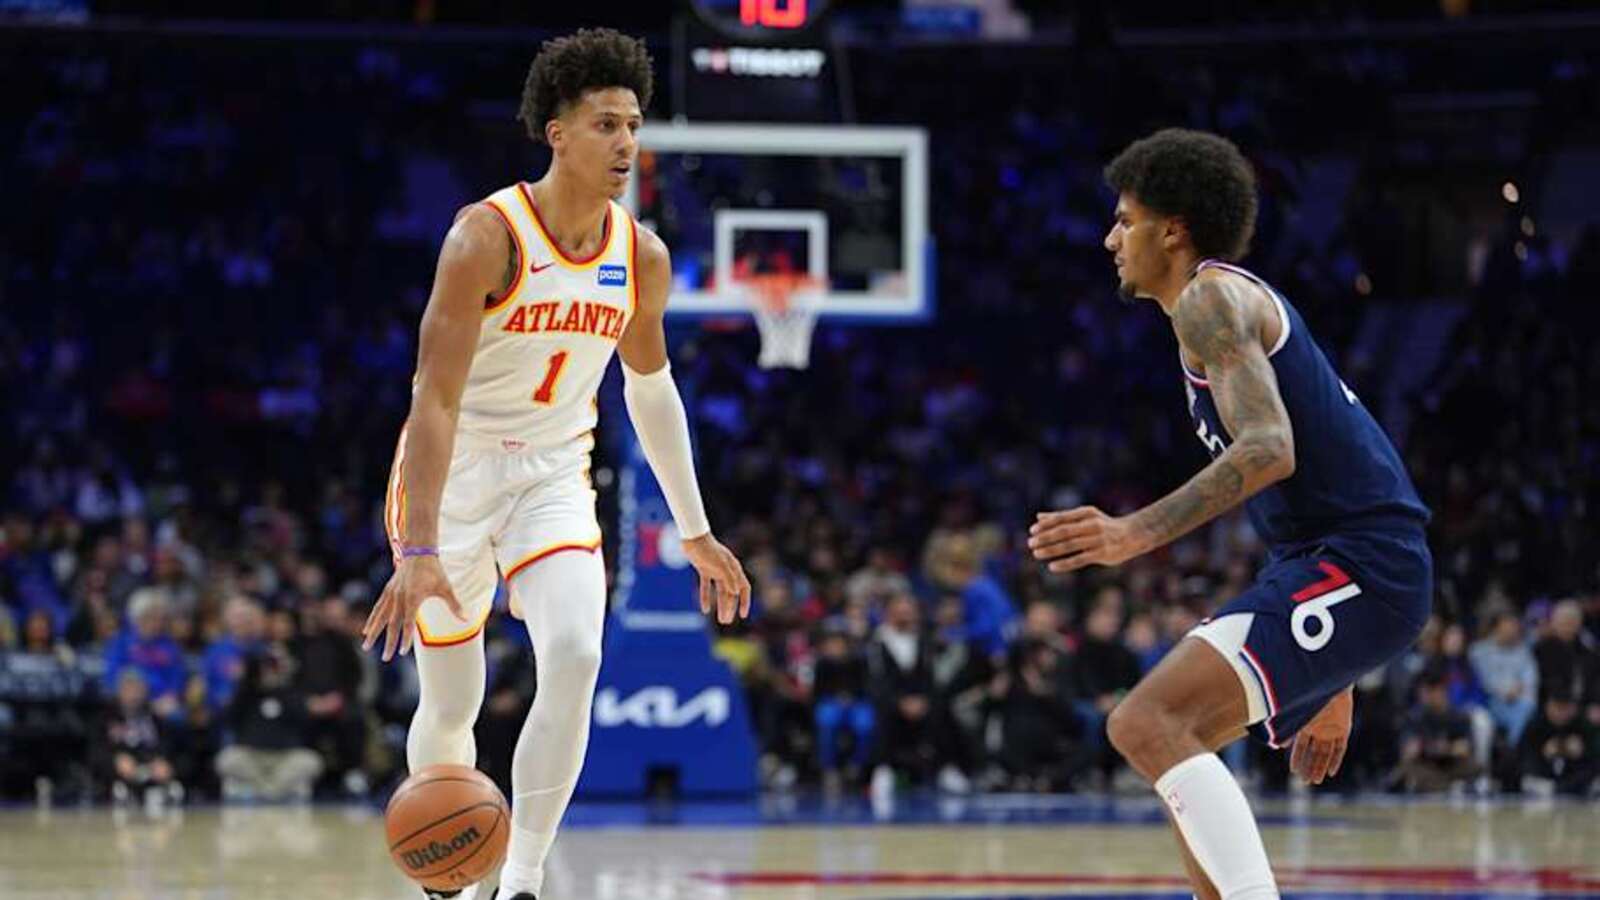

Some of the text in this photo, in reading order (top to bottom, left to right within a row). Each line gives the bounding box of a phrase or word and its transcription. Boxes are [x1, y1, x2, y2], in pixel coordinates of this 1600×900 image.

[502, 301, 625, 339] ATLANTA
[533, 351, 567, 404] 1
[1289, 560, 1362, 652] 76
[402, 827, 481, 869] Wilson
